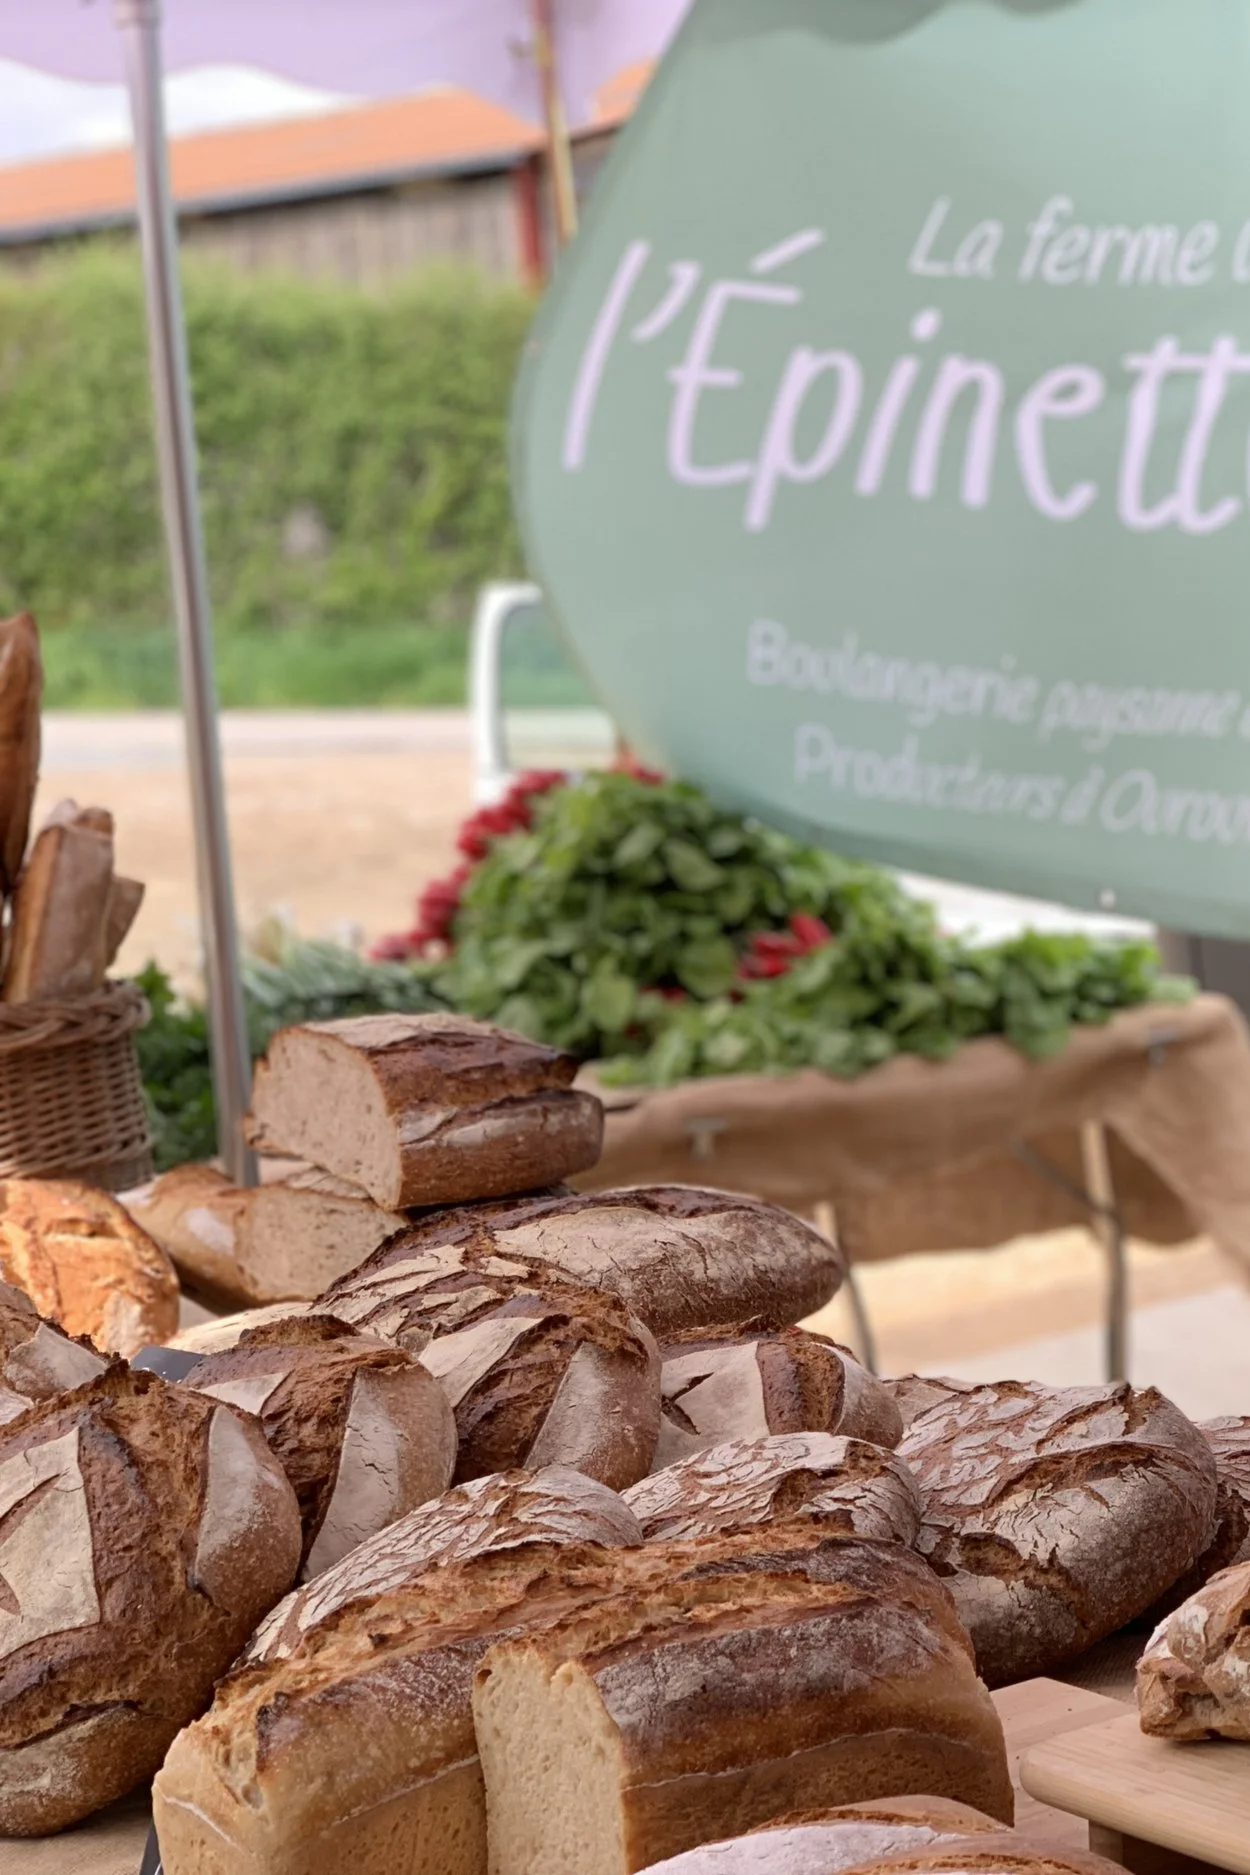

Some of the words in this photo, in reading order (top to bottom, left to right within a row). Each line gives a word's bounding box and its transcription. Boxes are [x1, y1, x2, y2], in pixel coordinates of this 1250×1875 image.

[908, 195, 1004, 280] La
[1017, 195, 1220, 286] ferme
[747, 617, 1041, 727] Boulangerie
